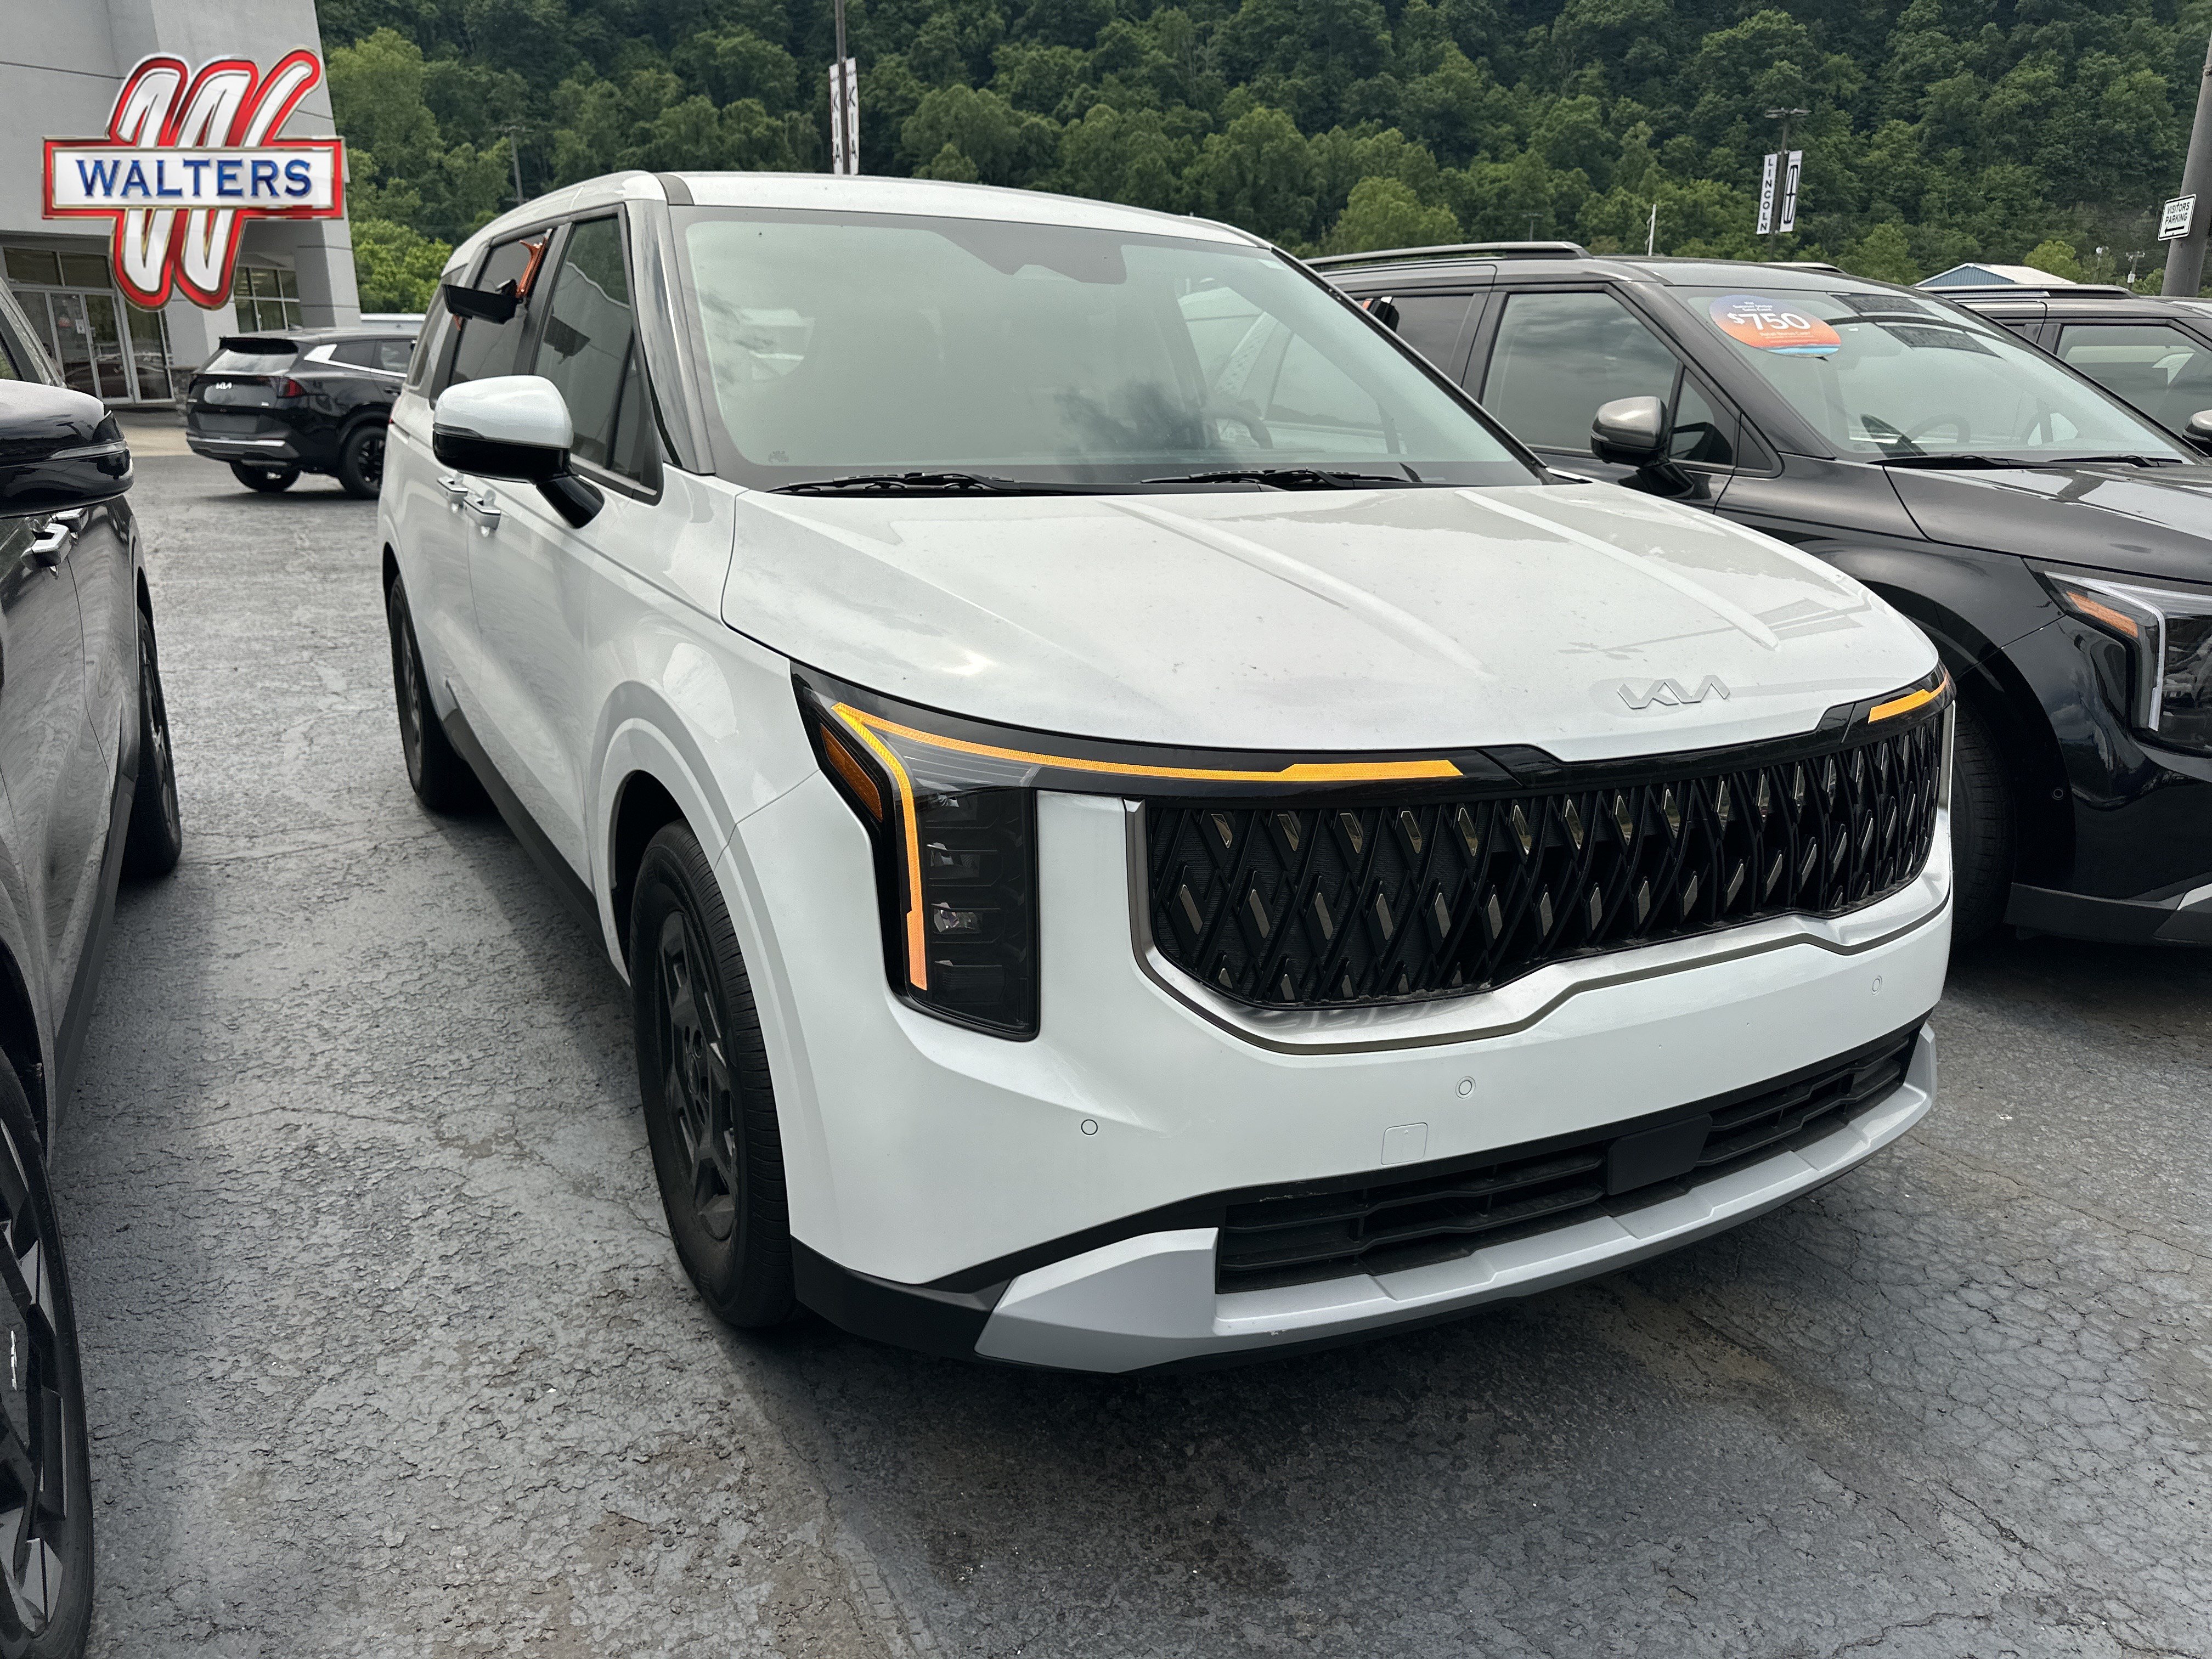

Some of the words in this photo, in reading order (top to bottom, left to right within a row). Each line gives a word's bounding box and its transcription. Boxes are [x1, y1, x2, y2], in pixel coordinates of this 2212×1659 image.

[848, 86, 857, 160] KIA
[1760, 158, 1774, 231] LINCOLN
[2165, 212, 2187, 225] PARKING
[2167, 201, 2190, 215] VISITORS
[1727, 312, 1811, 330] $750
[1617, 674, 1730, 709] KIA
